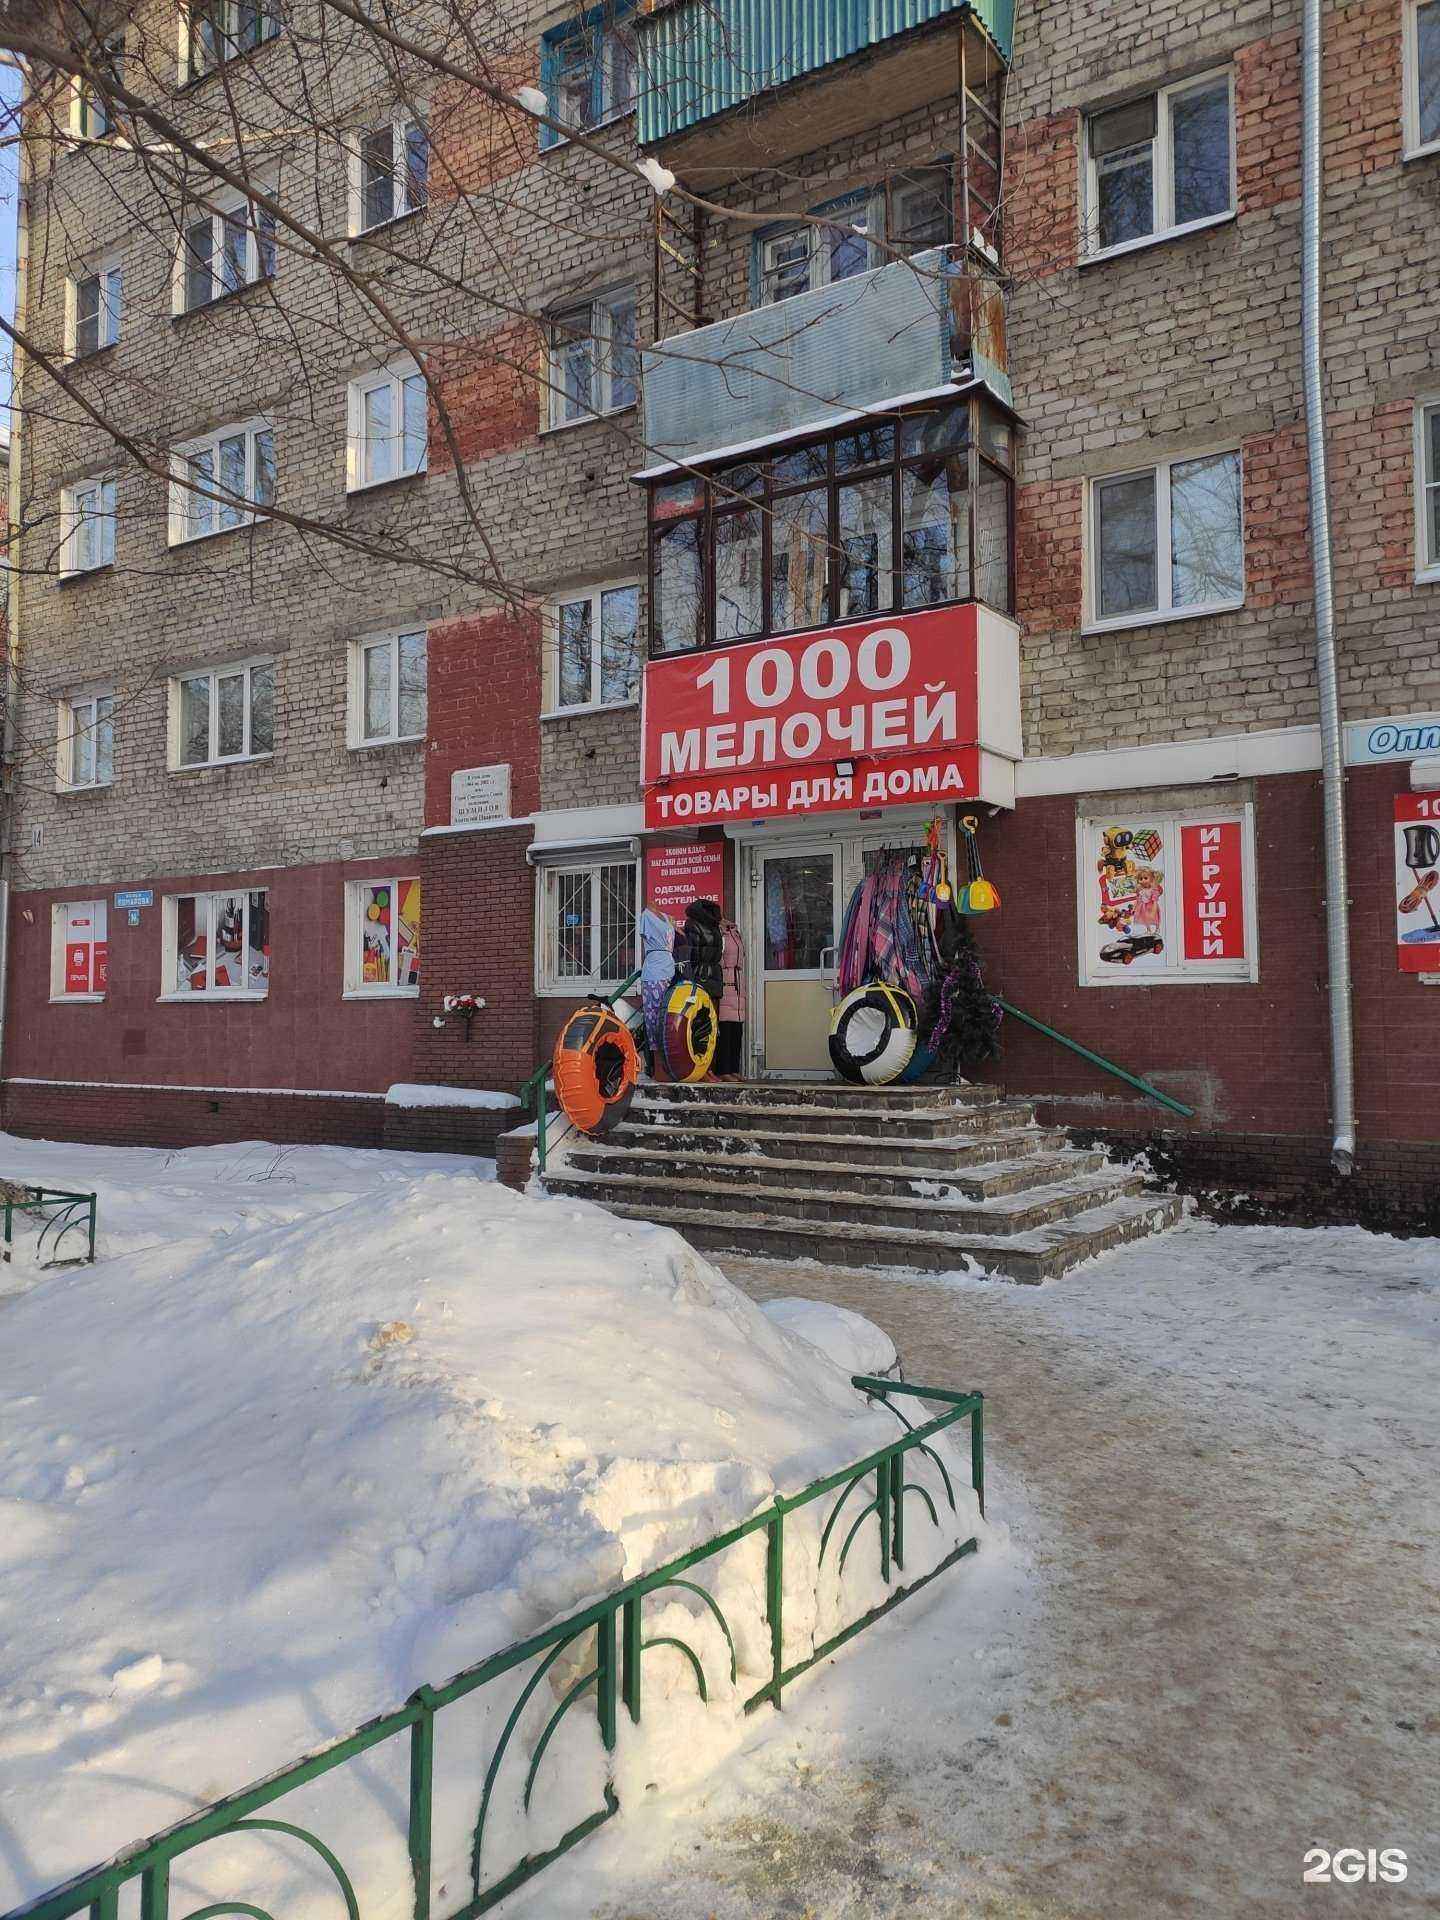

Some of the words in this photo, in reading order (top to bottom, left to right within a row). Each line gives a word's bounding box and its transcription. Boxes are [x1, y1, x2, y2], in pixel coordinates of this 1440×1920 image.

[696, 628, 912, 715] 1000
[660, 681, 957, 775] МЕЛОЧЕЙ
[657, 783, 778, 818] ТОВАРЫ
[787, 775, 853, 809] ДЛЯ
[862, 764, 964, 803] ДОМА
[654, 884, 696, 895] ОДЕЖДА
[1198, 827, 1227, 956] ИГРУШКИ
